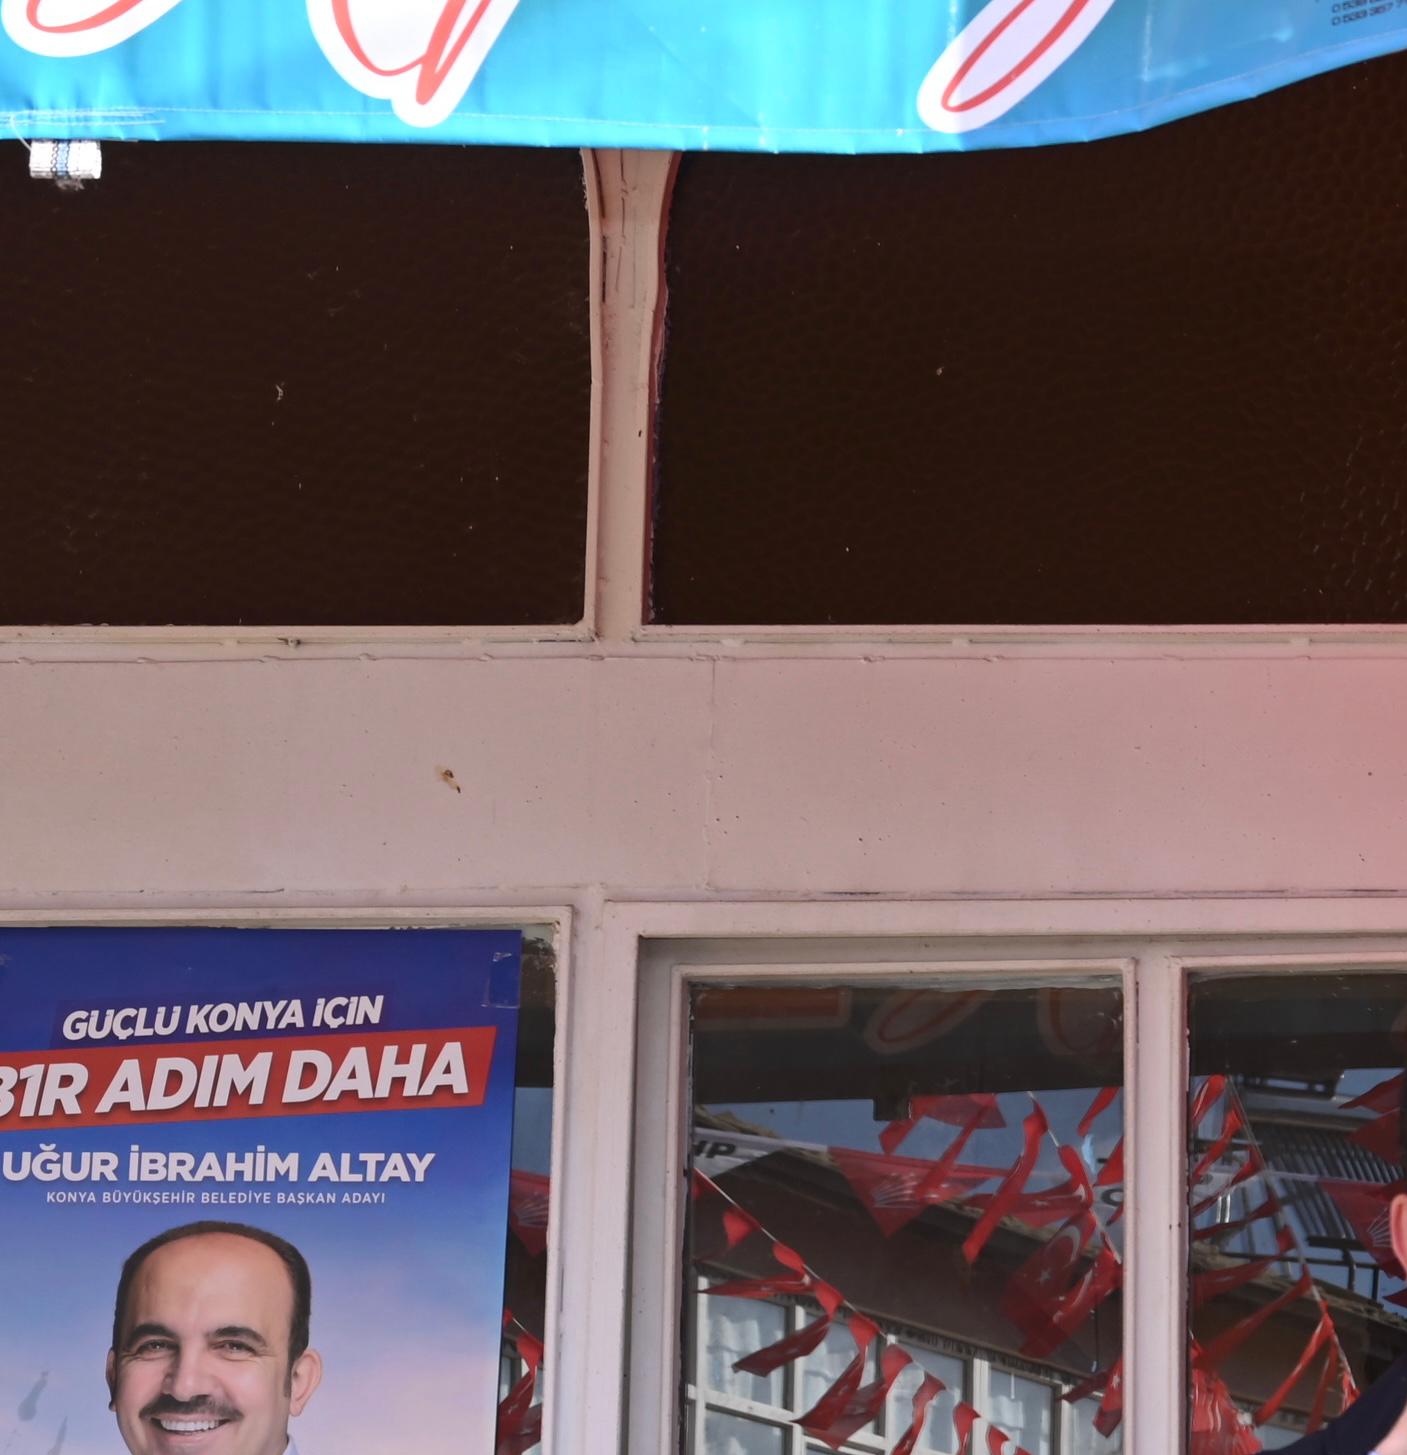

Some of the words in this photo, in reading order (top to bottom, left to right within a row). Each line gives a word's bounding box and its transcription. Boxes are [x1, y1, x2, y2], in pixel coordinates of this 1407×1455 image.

[185, 999, 305, 1035] KONYA
[94, 1051, 273, 1114] ADIM
[281, 1041, 469, 1104] DAHA
[2, 1143, 119, 1182] UĞUR
[128, 1144, 299, 1182] İBRAHİM
[307, 1152, 436, 1182] ALTAY
[46, 1191, 97, 1203] KONYA
[102, 1189, 195, 1206] BÜYÜKŞEHİR
[201, 1189, 271, 1204] BELEDİYE
[276, 1191, 336, 1206] BAŞKAN
[341, 1192, 385, 1204] ADAYI
